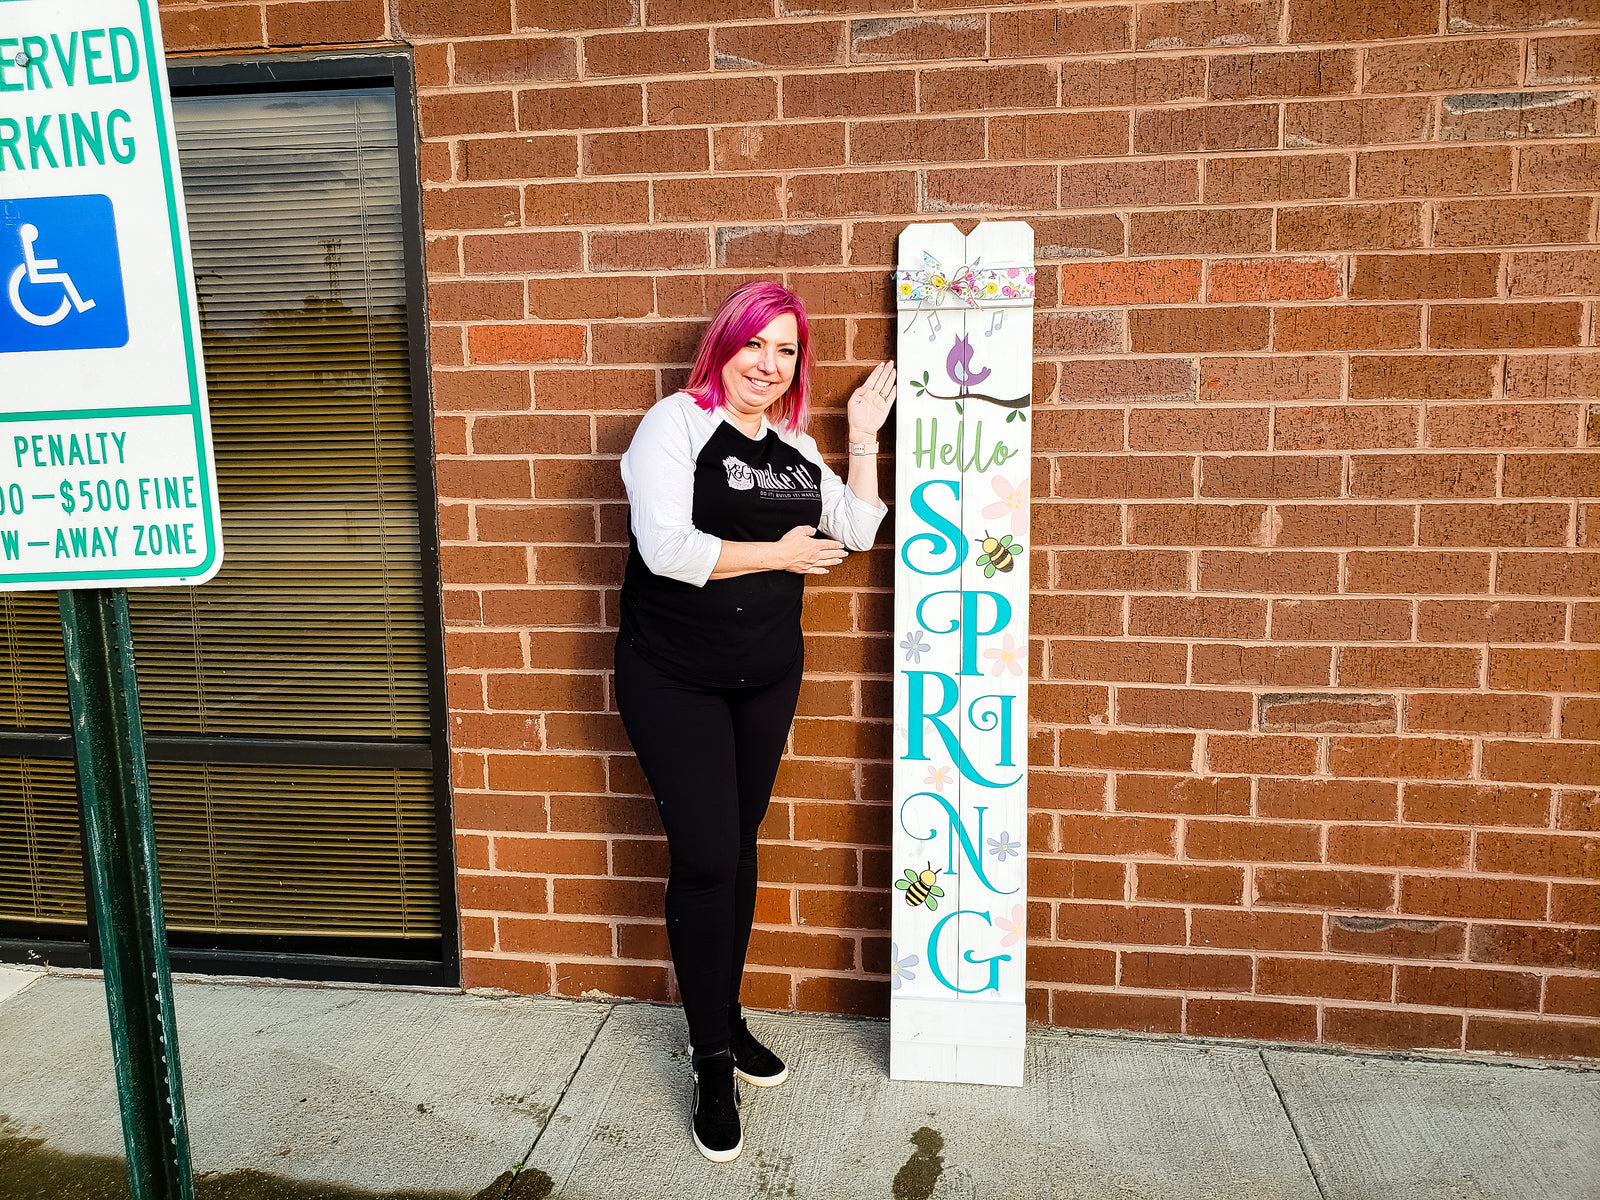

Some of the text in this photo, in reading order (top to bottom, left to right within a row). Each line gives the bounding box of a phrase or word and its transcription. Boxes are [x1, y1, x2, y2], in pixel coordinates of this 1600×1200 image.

[14, 431, 126, 467] PENALTY
[912, 417, 1018, 473] Hello
[138, 476, 197, 510] FINE
[751, 463, 797, 490] make
[132, 523, 197, 556] ZONE
